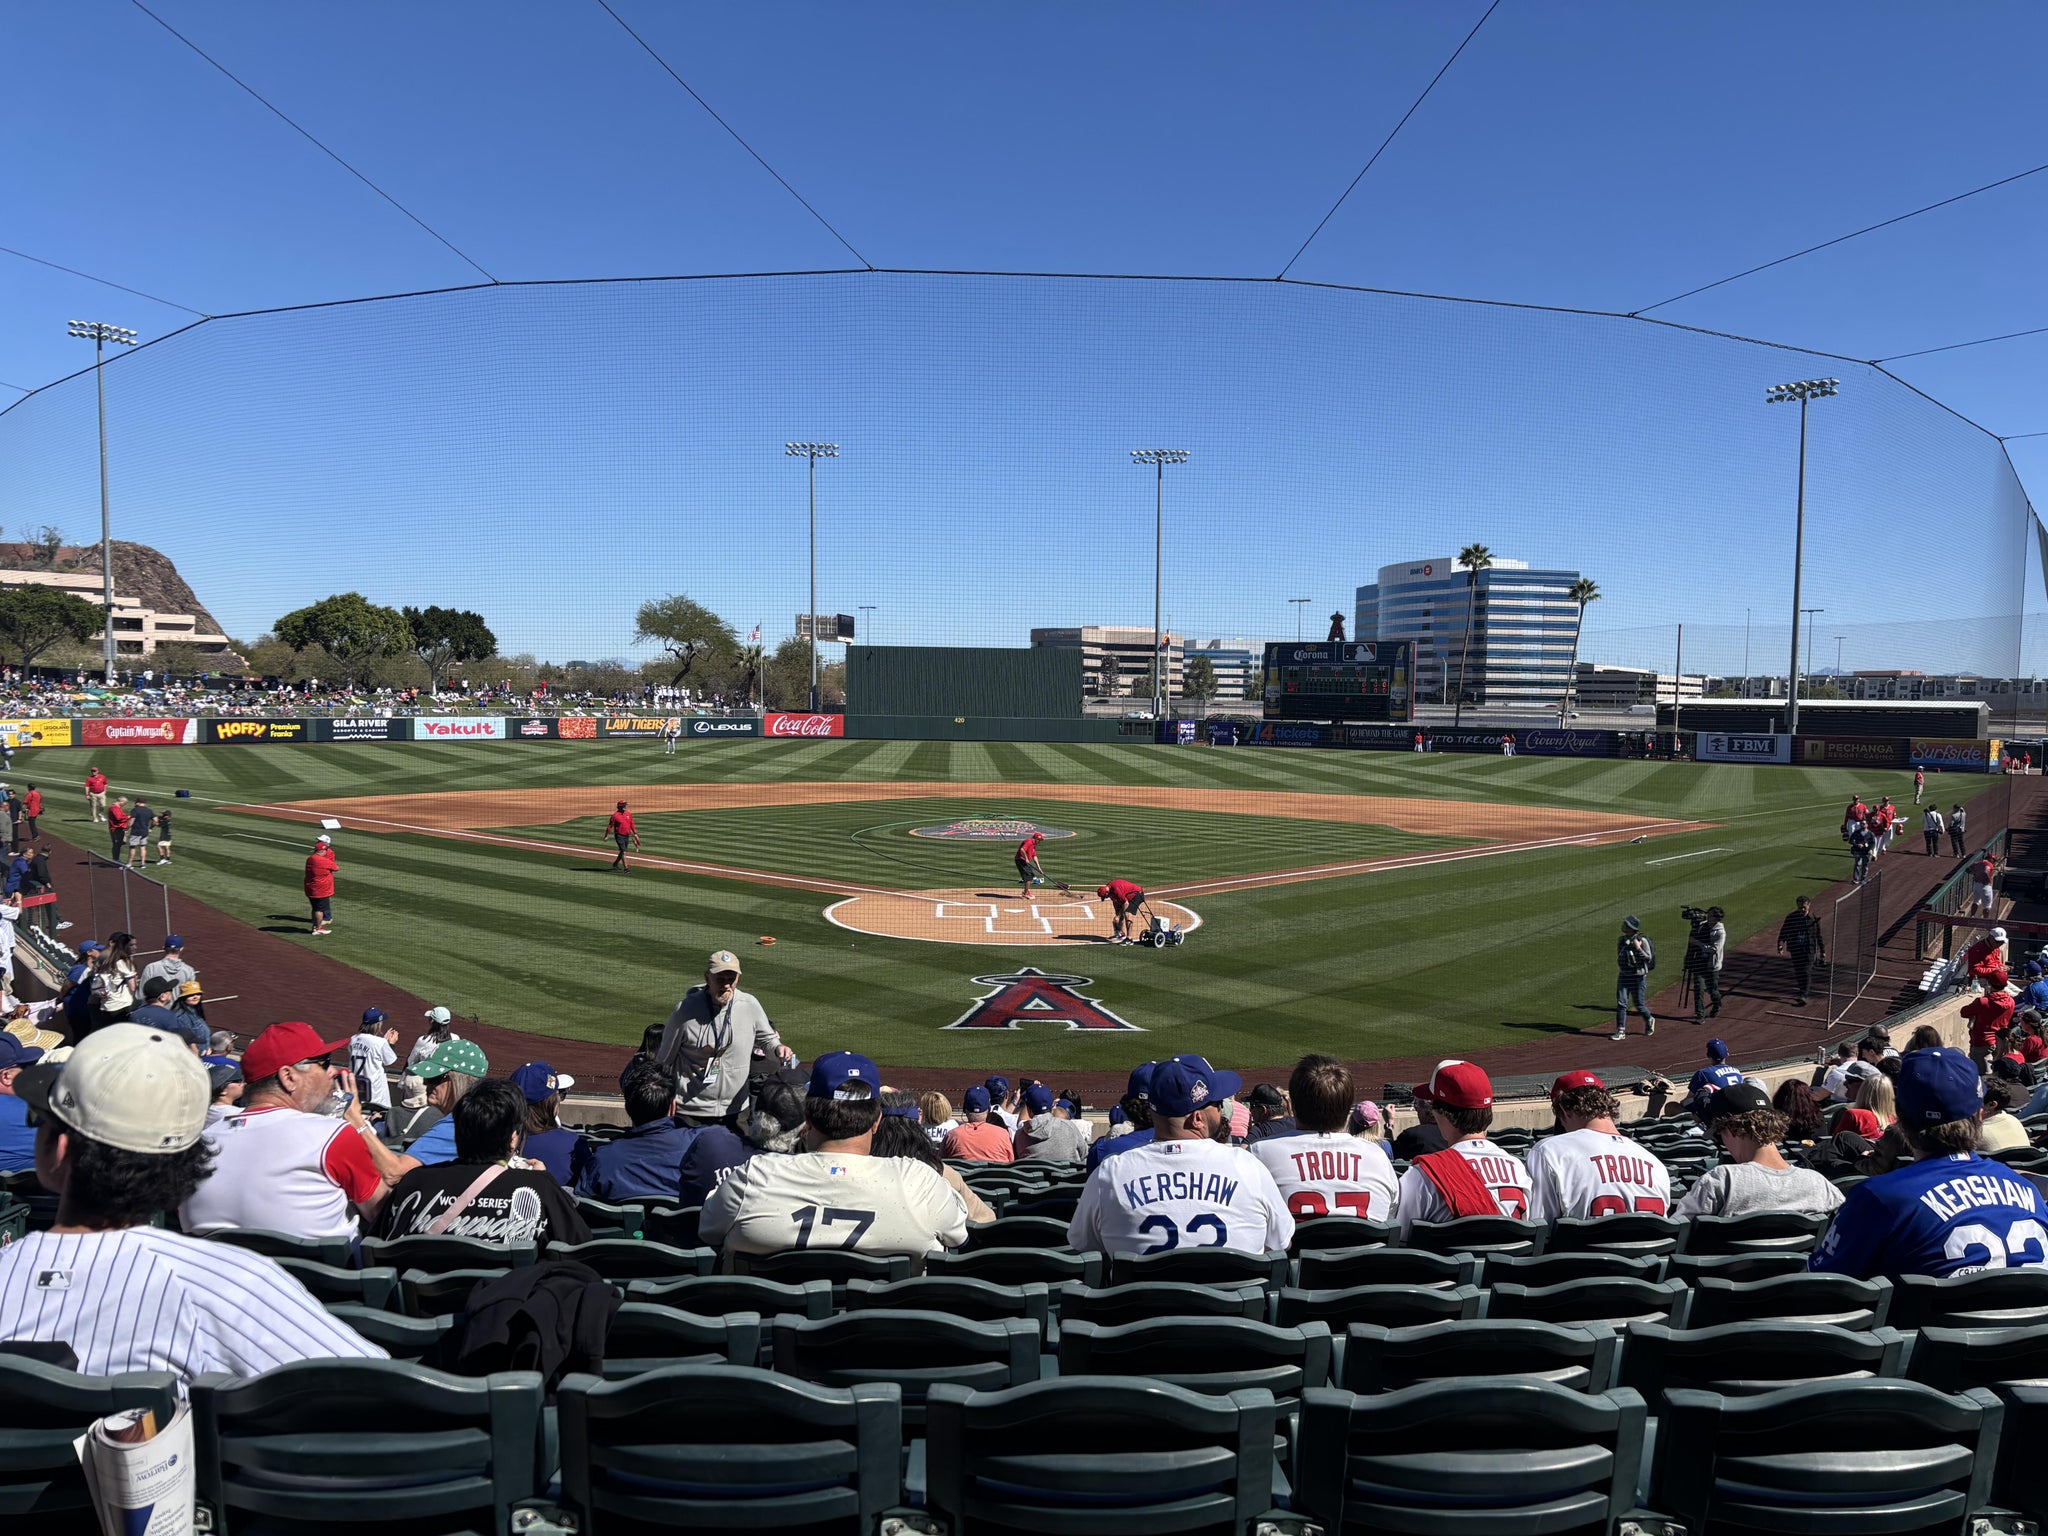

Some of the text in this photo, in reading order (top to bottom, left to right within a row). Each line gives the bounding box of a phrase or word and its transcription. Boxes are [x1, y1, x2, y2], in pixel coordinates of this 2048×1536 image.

[1293, 650, 1328, 662] Corona
[217, 722, 267, 739] HOFFY
[270, 723, 301, 731] Premium
[333, 720, 388, 728] GILA RIVER
[423, 722, 495, 735] Yakult
[605, 719, 666, 730] LAW TIGERS
[710, 723, 753, 731] LEXUS
[106, 725, 163, 739] Captain Morgan
[1350, 729, 1358, 737] GO
[1430, 735, 1453, 743] ITTO
[1526, 730, 1600, 752] Crown Royal
[1732, 739, 1770, 752] FBM
[1828, 743, 1894, 754] PECHANGA
[1911, 741, 1981, 760] Surfside
[1290, 1151, 1362, 1182] TROUT
[1465, 1156, 1518, 1185] ROUT
[1589, 1154, 1654, 1188] TROUT
[1122, 1171, 1239, 1210] KERSHAW
[440, 1196, 509, 1209] WOD SERIES
[1919, 1175, 2036, 1222] KERSHAW
[385, 1190, 538, 1241] Chmpions
[790, 1204, 876, 1250] 17
[136, 1463, 168, 1483] Barrow
